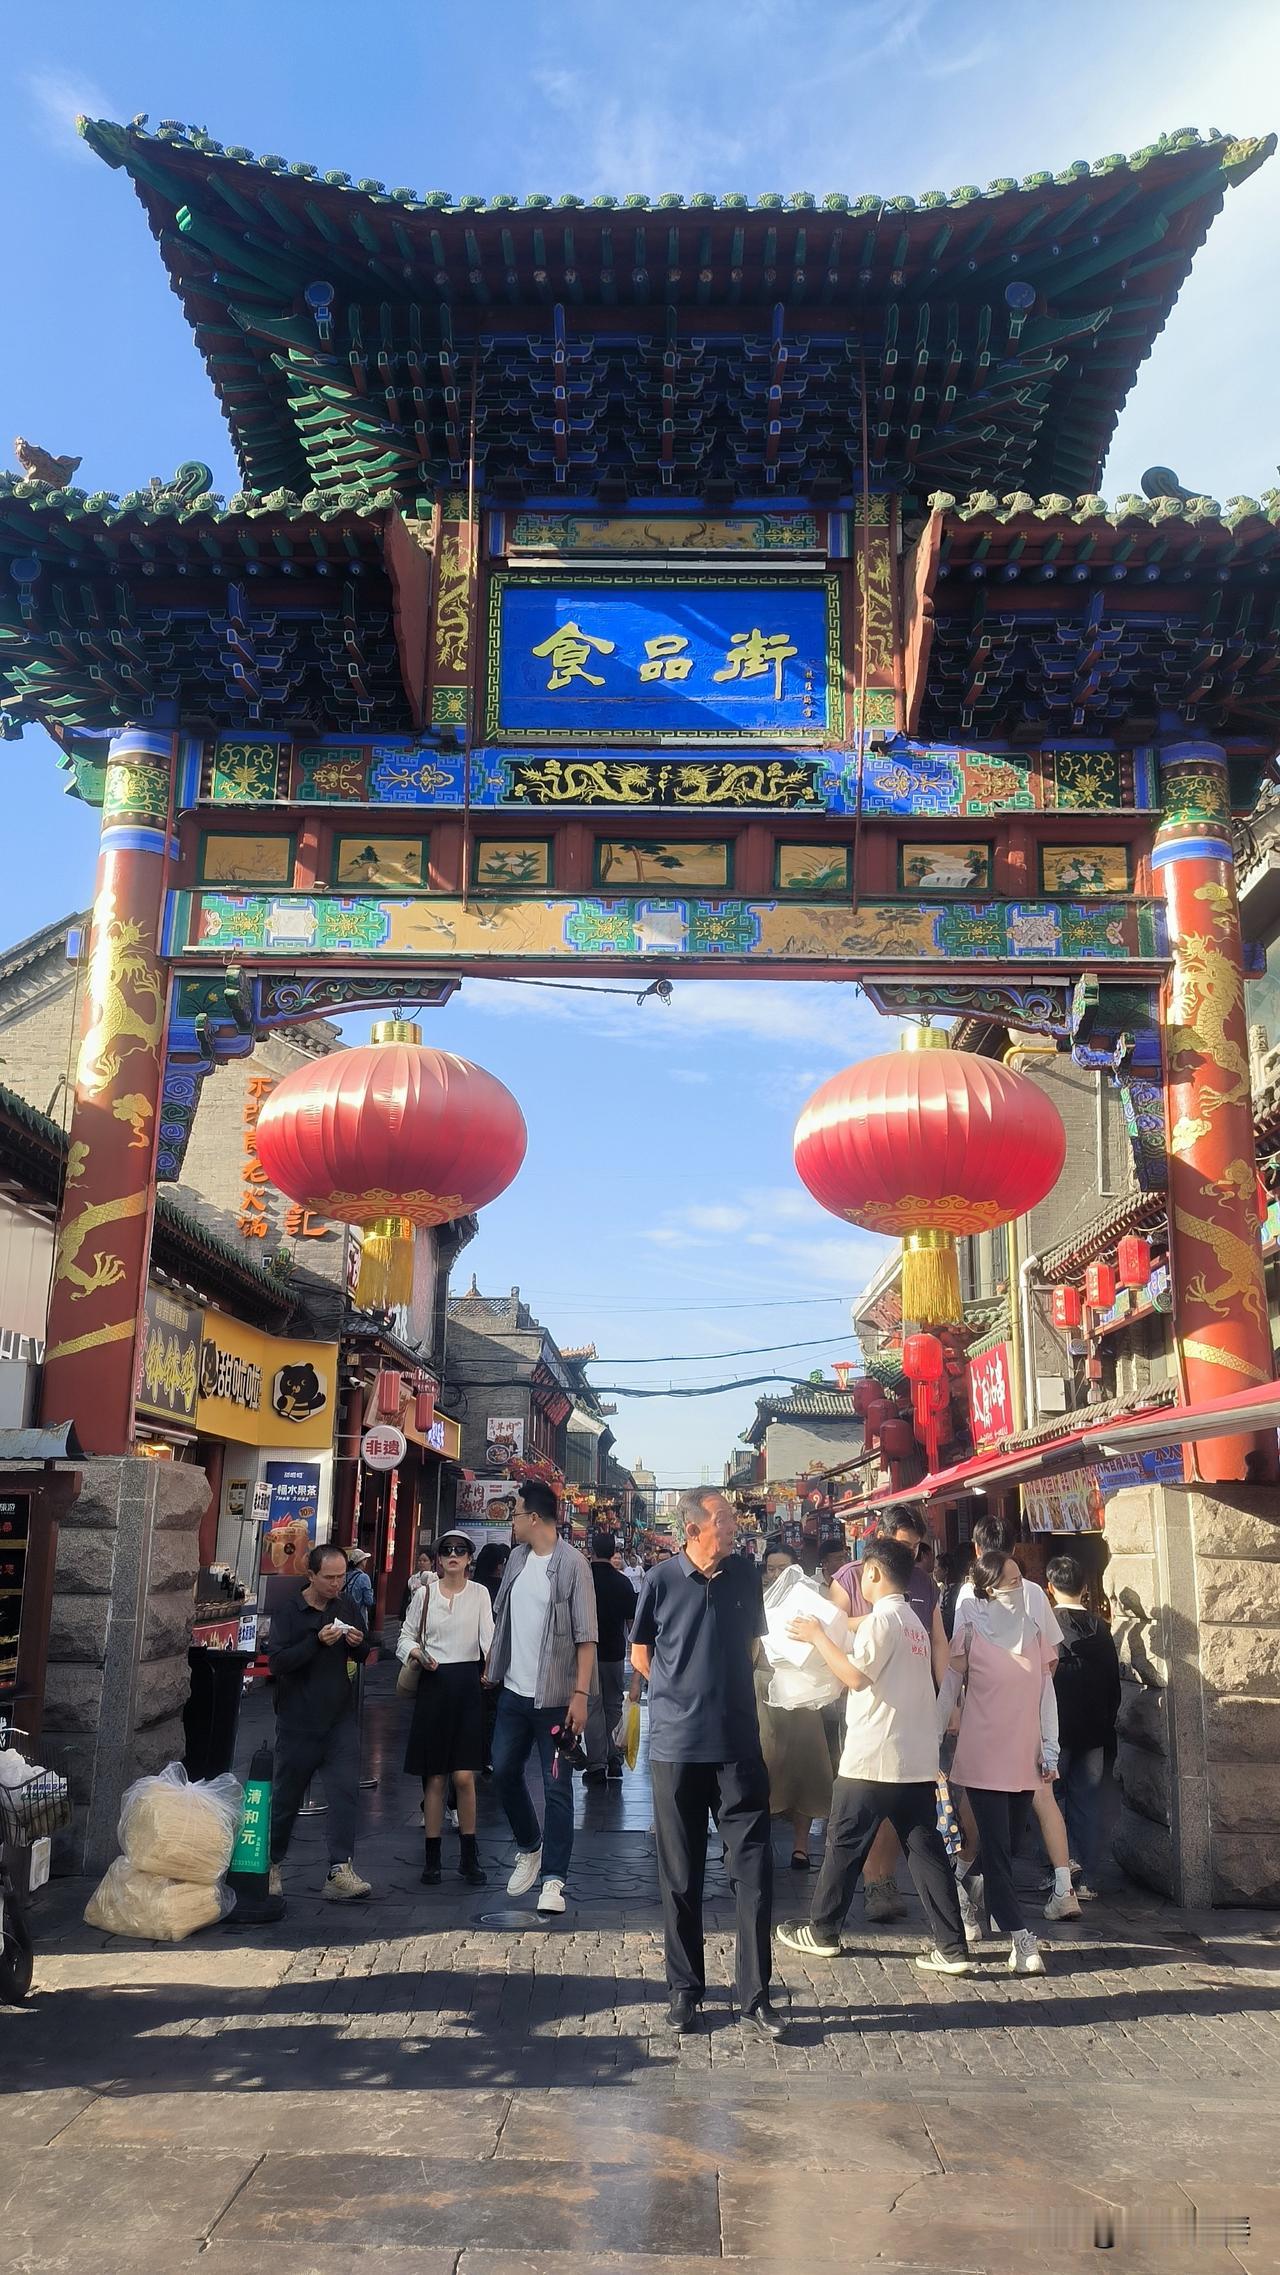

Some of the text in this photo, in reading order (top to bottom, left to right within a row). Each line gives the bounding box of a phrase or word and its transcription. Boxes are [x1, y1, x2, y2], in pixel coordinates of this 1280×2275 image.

[532, 621, 798, 701] 食品街
[366, 1439, 400, 1456] 非遗
[241, 1788, 263, 1846] 清和元
